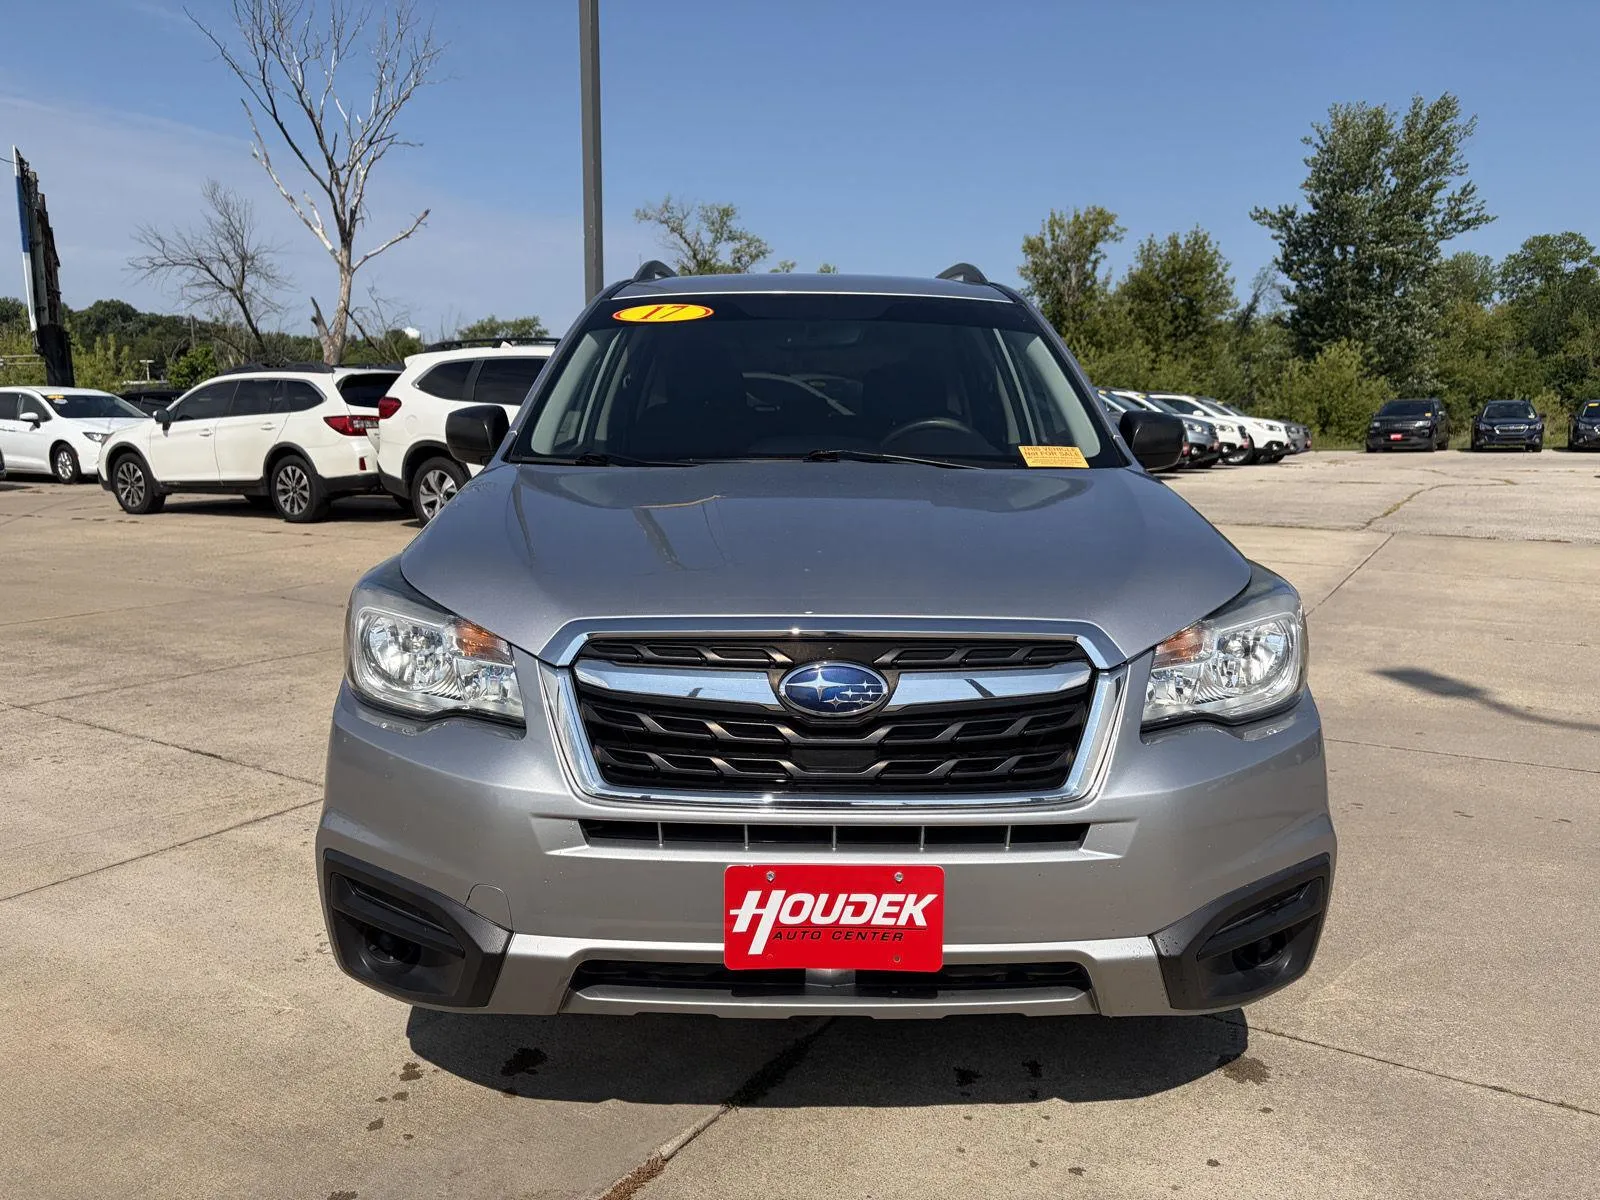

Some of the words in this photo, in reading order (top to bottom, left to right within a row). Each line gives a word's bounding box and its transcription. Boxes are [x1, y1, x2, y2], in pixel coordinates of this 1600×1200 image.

[639, 305, 689, 320] 17
[729, 889, 938, 955] HOUDEK
[772, 930, 822, 941] AUTO
[831, 930, 904, 942] CENTER
